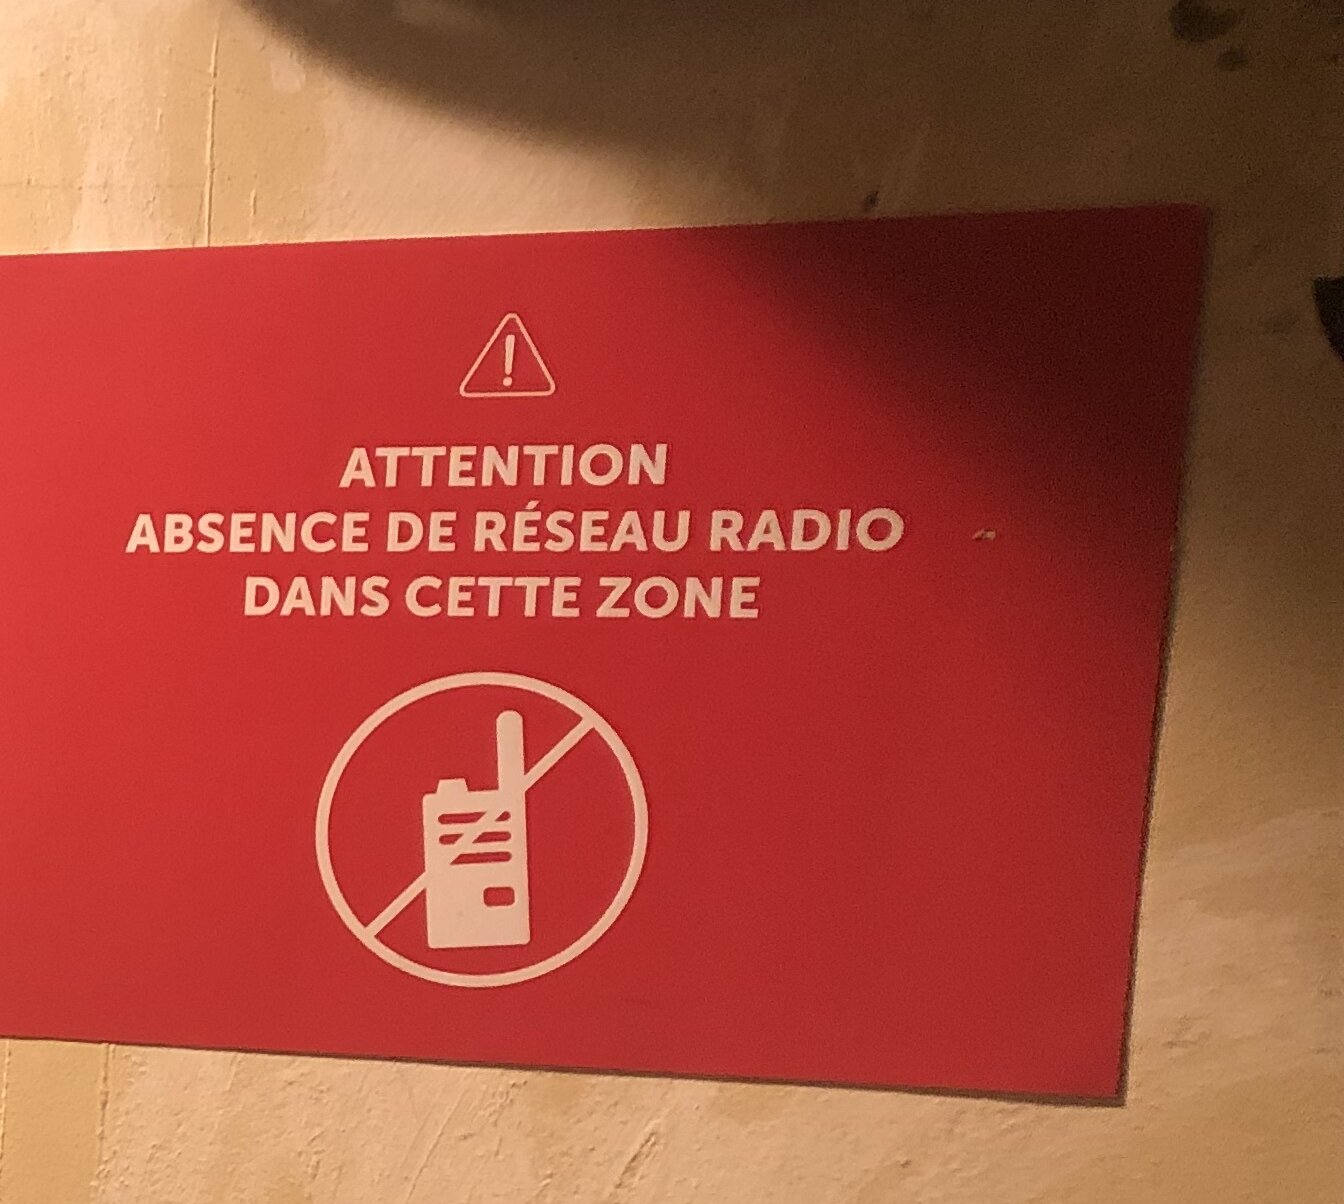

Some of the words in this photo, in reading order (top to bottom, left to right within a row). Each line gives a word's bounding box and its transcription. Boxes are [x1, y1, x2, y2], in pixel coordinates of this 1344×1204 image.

[338, 443, 670, 488] ATTENTION
[125, 512, 370, 555] ABSENCE
[385, 511, 457, 554] DE
[474, 499, 692, 554] RÉSEAU
[710, 506, 906, 553] RADIO
[243, 574, 391, 618] DANS
[404, 575, 581, 619] CETTE
[596, 574, 762, 619] ZONE
